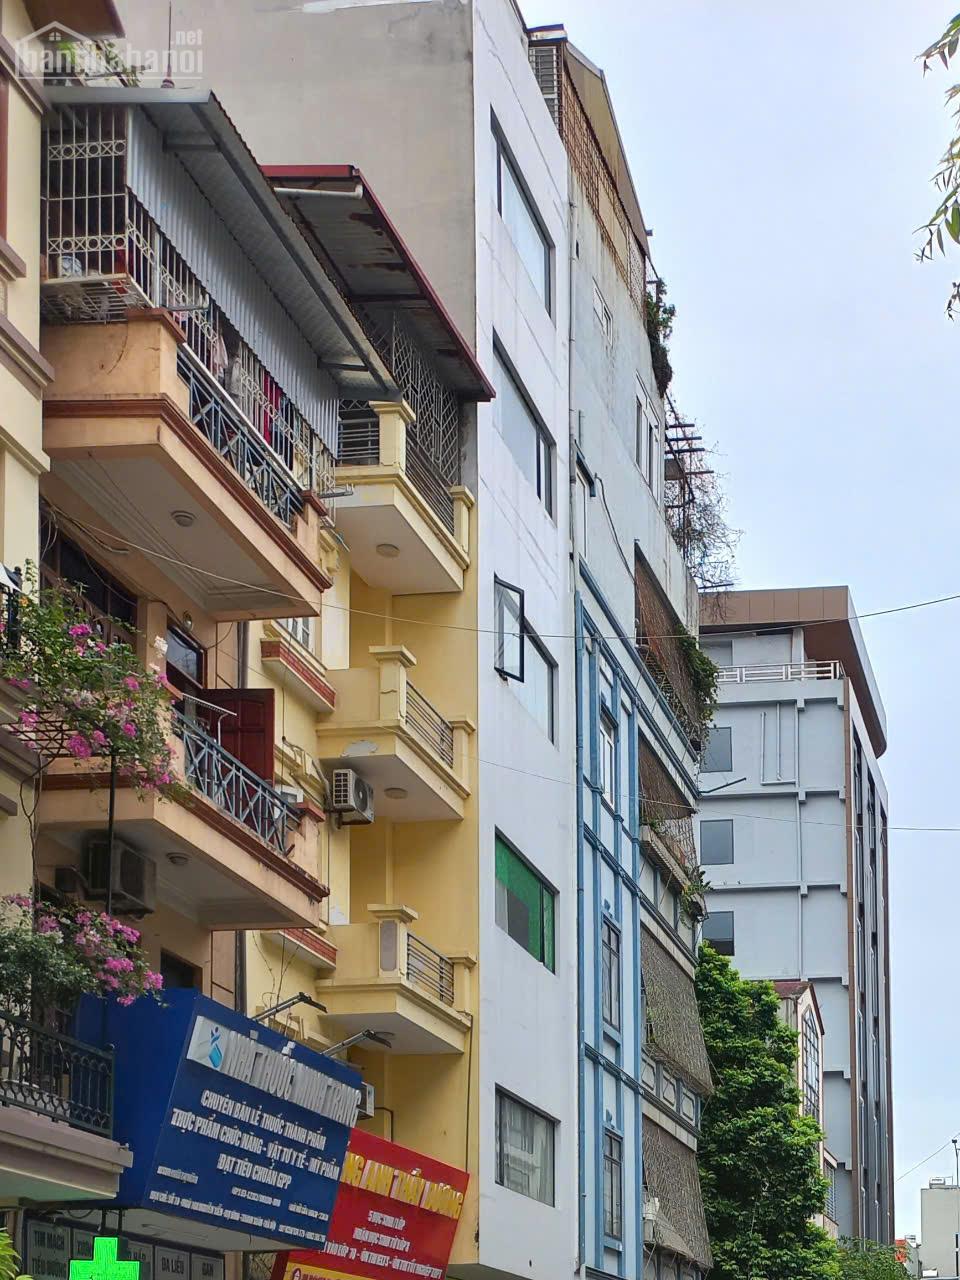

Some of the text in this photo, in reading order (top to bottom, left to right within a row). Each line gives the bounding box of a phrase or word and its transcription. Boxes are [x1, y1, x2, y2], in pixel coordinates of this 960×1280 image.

[223, 1029, 259, 1083] NHÀ
[250, 1041, 297, 1100] THUỐC
[321, 1076, 362, 1128] TRANG
[171, 1108, 195, 1134] THỰC
[194, 1113, 220, 1140] PHẨM
[201, 1089, 232, 1117] CHUYÊN
[261, 1112, 285, 1133] THUỐC
[217, 1154, 235, 1174] ĐẠT
[276, 1172, 292, 1189] GPP
